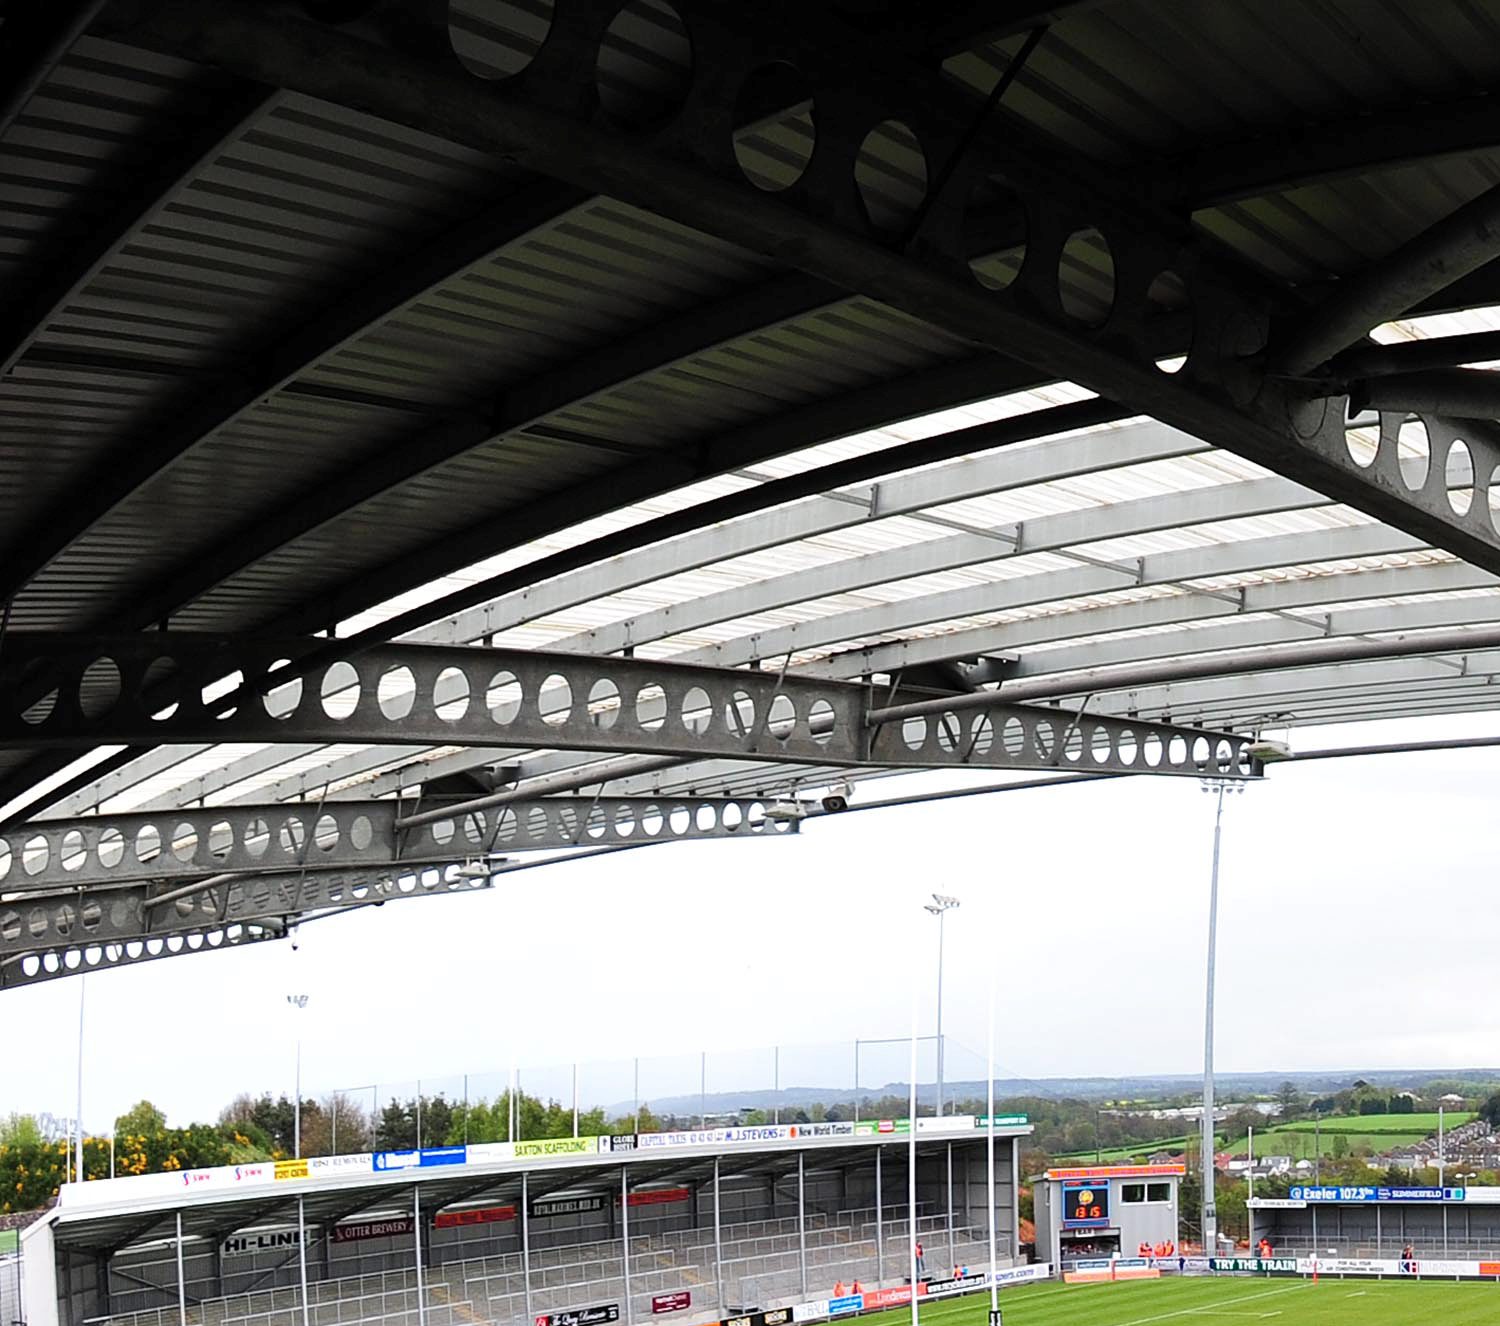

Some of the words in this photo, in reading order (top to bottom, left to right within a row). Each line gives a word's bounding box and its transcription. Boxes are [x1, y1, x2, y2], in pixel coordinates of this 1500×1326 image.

[799, 1125, 813, 1136] New
[814, 1125, 830, 1136] World
[831, 1123, 853, 1136] Timber
[345, 1225, 371, 1238] OTTER
[372, 1221, 408, 1236] BREWERY
[224, 1231, 307, 1252] HI-LINE
[1215, 1258, 1234, 1271] TRY
[1237, 1258, 1258, 1271] THE
[1260, 1259, 1296, 1272] TRAIN
